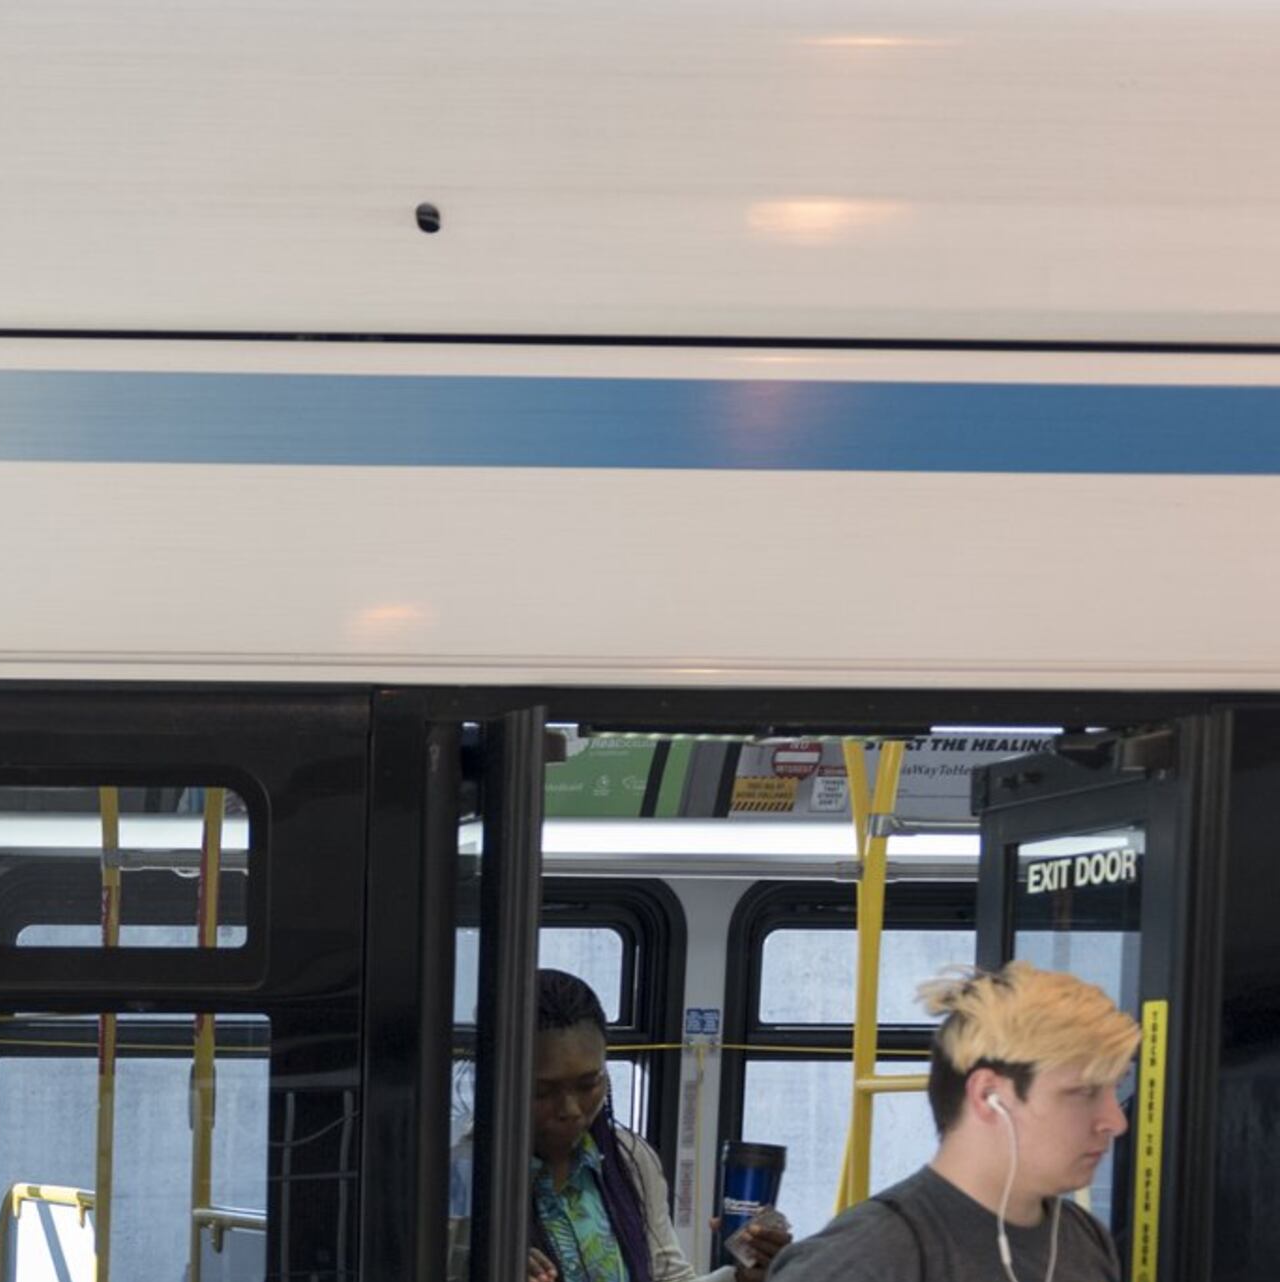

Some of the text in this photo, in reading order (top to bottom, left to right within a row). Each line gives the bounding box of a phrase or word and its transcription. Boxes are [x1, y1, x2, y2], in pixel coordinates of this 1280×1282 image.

[931, 738, 968, 752] THE
[1027, 849, 1138, 894] EXIT DOOR
